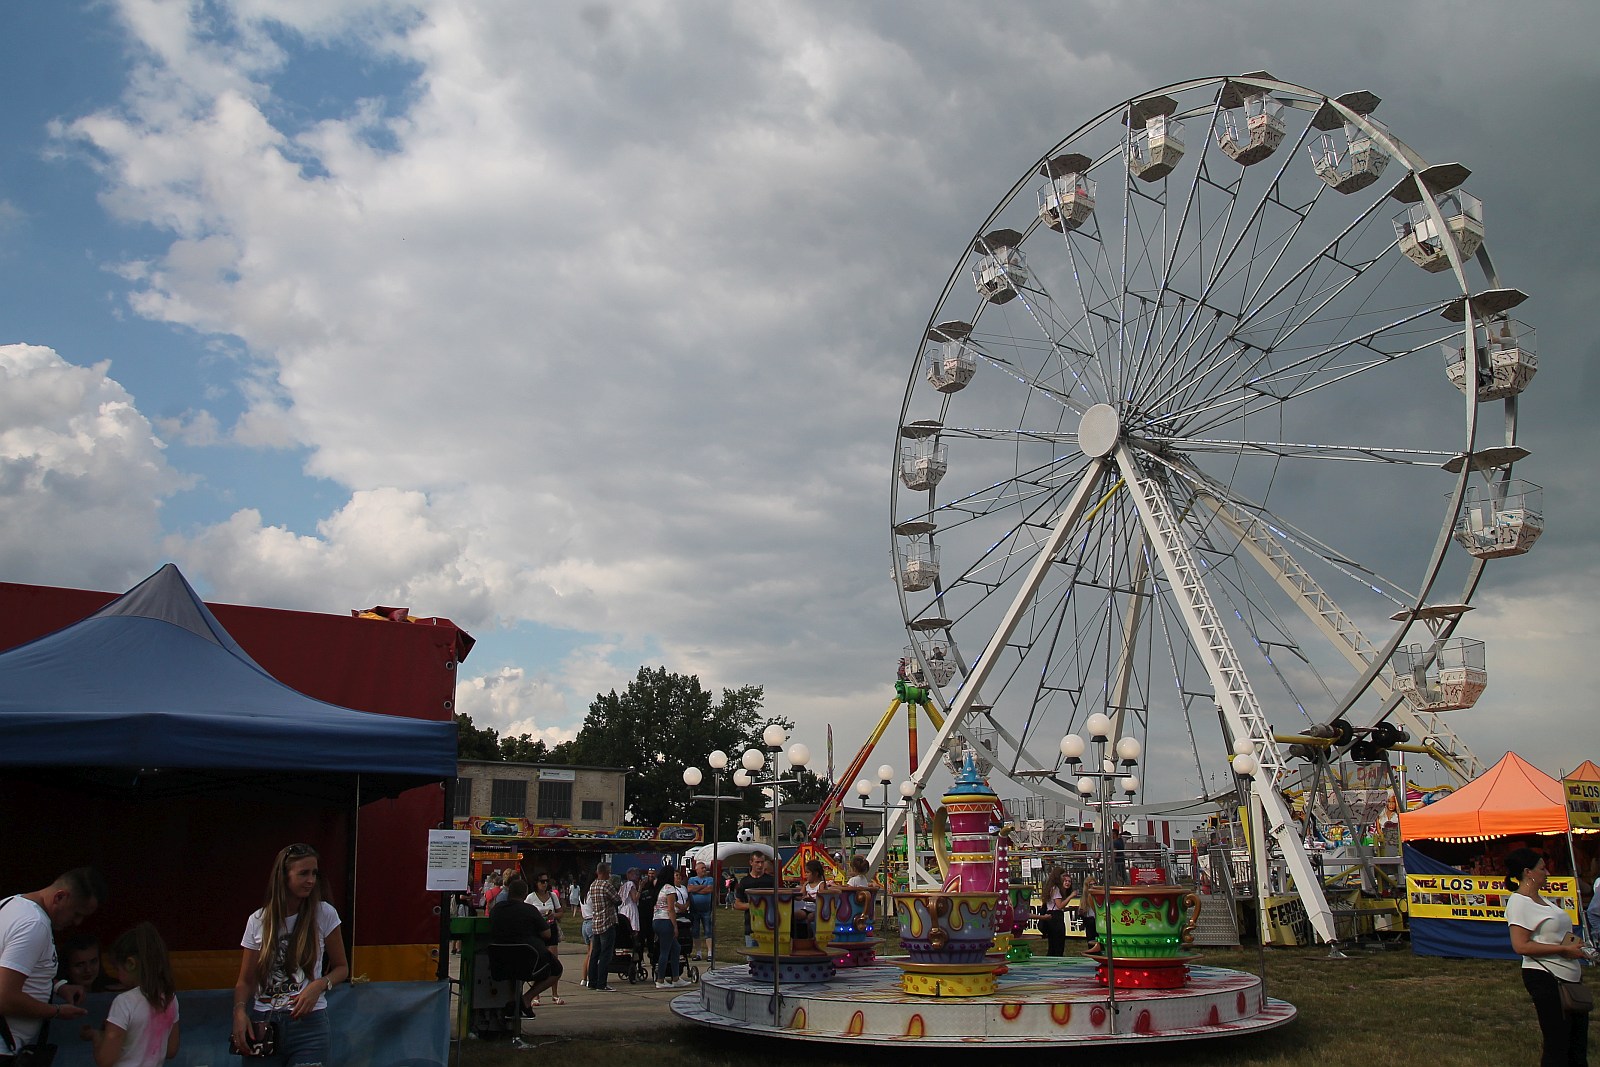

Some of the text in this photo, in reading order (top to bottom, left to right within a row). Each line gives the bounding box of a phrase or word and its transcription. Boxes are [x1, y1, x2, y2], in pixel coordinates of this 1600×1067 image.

[1582, 785, 1600, 798] LOS
[1413, 878, 1569, 893] WEŹ LOS W SW ĘCE
[1470, 909, 1485, 918] MA
[1486, 910, 1505, 918] PUS
